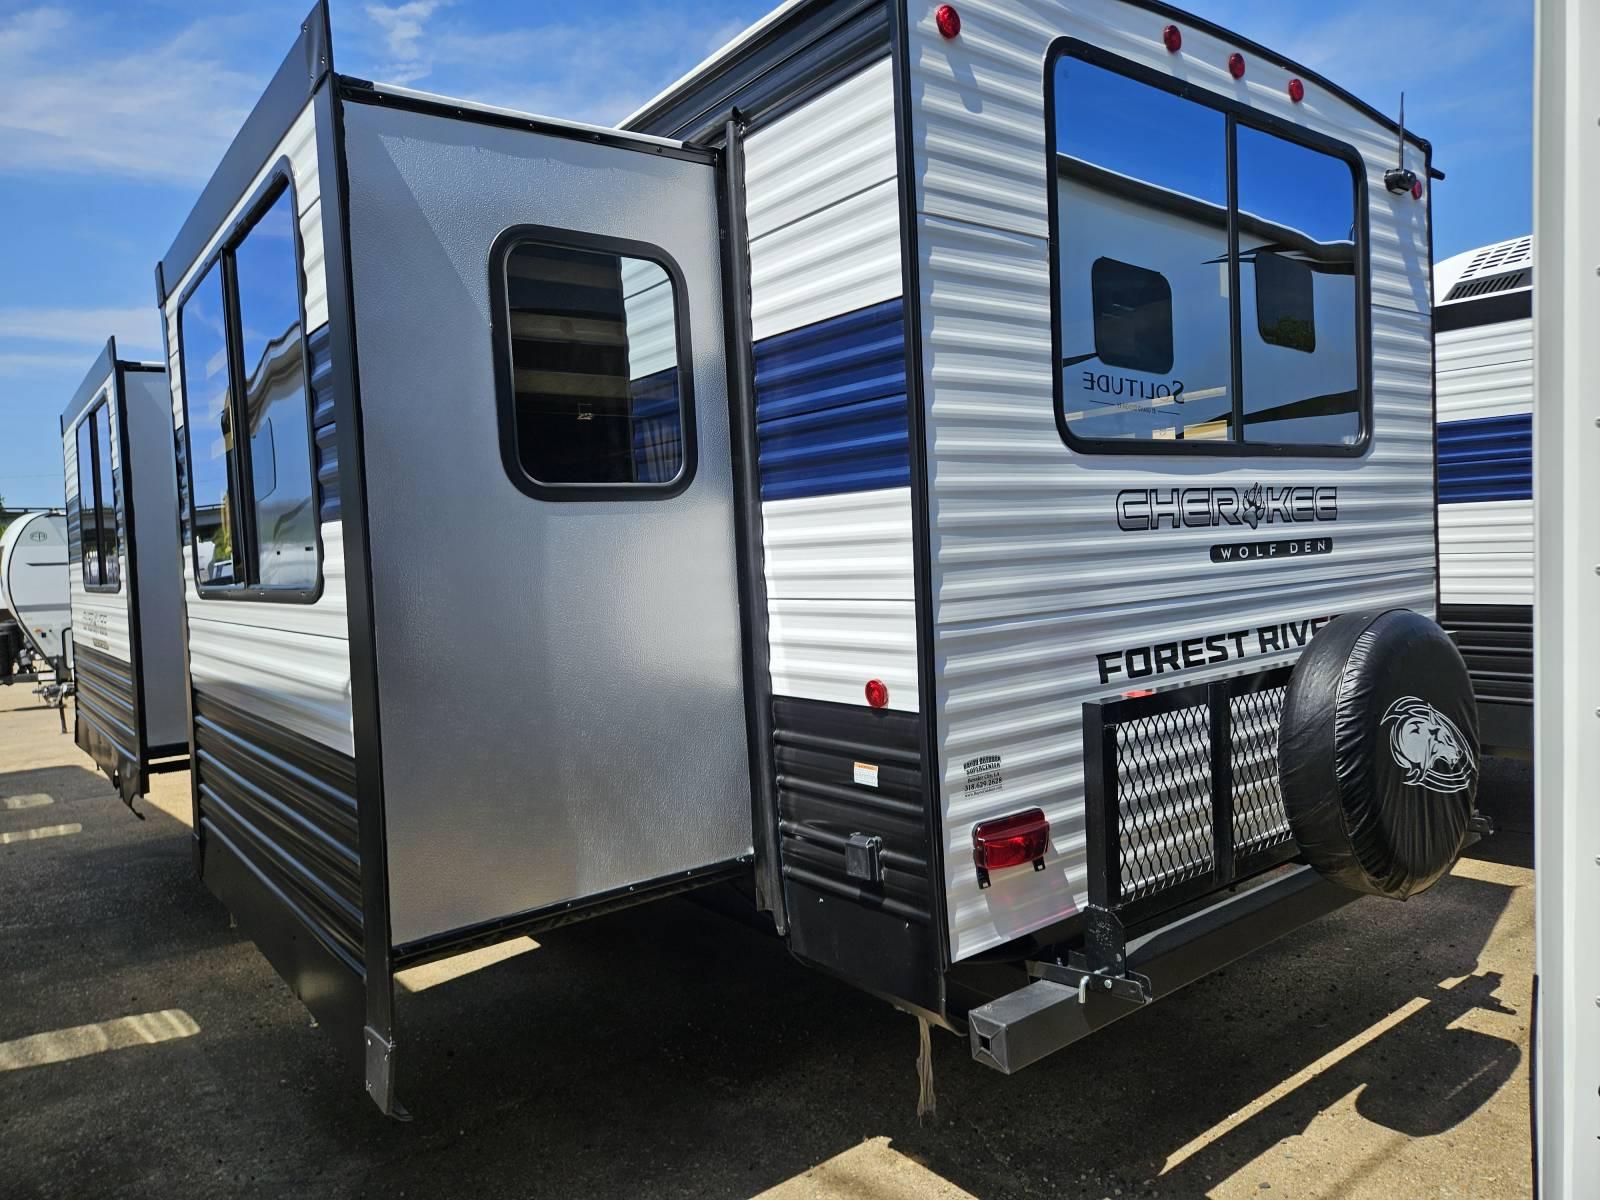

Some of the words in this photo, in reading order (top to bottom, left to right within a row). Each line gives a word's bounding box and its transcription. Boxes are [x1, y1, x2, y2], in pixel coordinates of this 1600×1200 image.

[1220, 544, 1277, 560] WOLF
[1289, 539, 1326, 554] DEN
[1096, 629, 1249, 684] FOREST
[1256, 613, 1344, 653] RIVE
